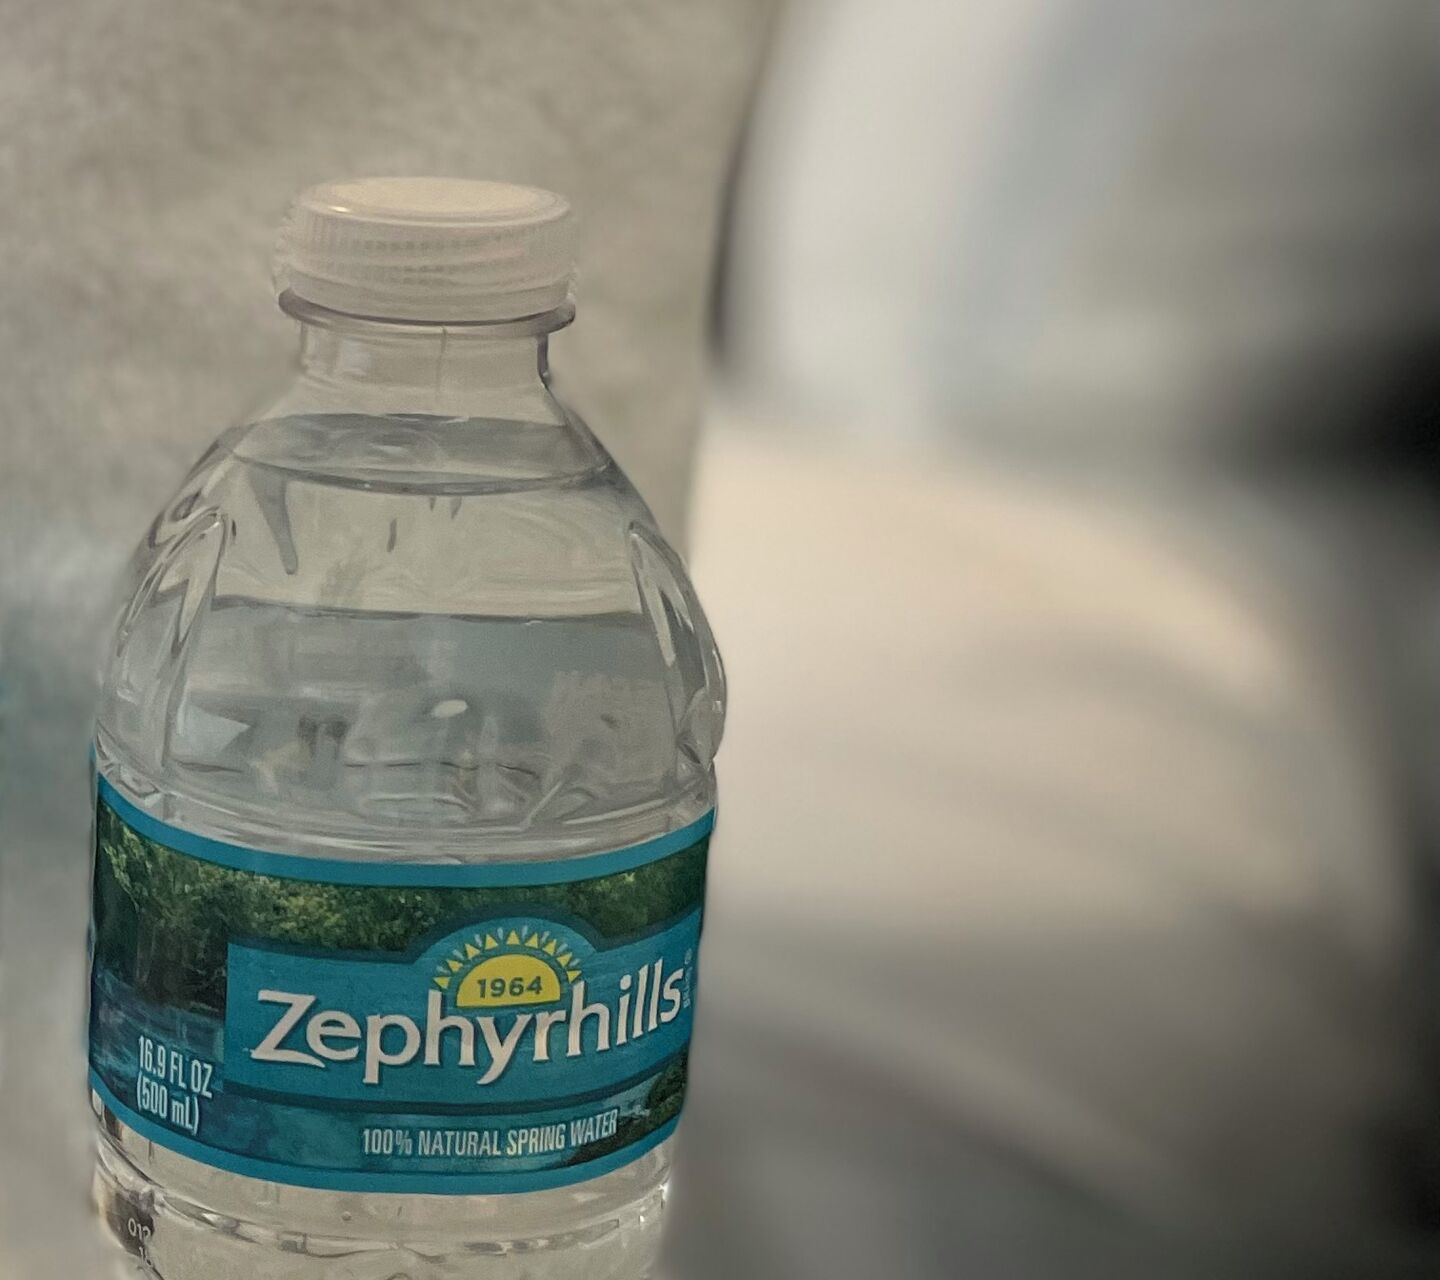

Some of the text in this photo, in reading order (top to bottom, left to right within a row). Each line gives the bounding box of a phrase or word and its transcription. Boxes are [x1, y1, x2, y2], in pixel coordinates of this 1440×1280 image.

[476, 975, 543, 1000] 1964
[250, 956, 684, 1085] Zephyrhills
[139, 1035, 213, 1098] 16.9 FL OZ
[137, 1071, 199, 1136] (500 mL)
[363, 1109, 619, 1156] 100% NATURAL SPRING WATER
